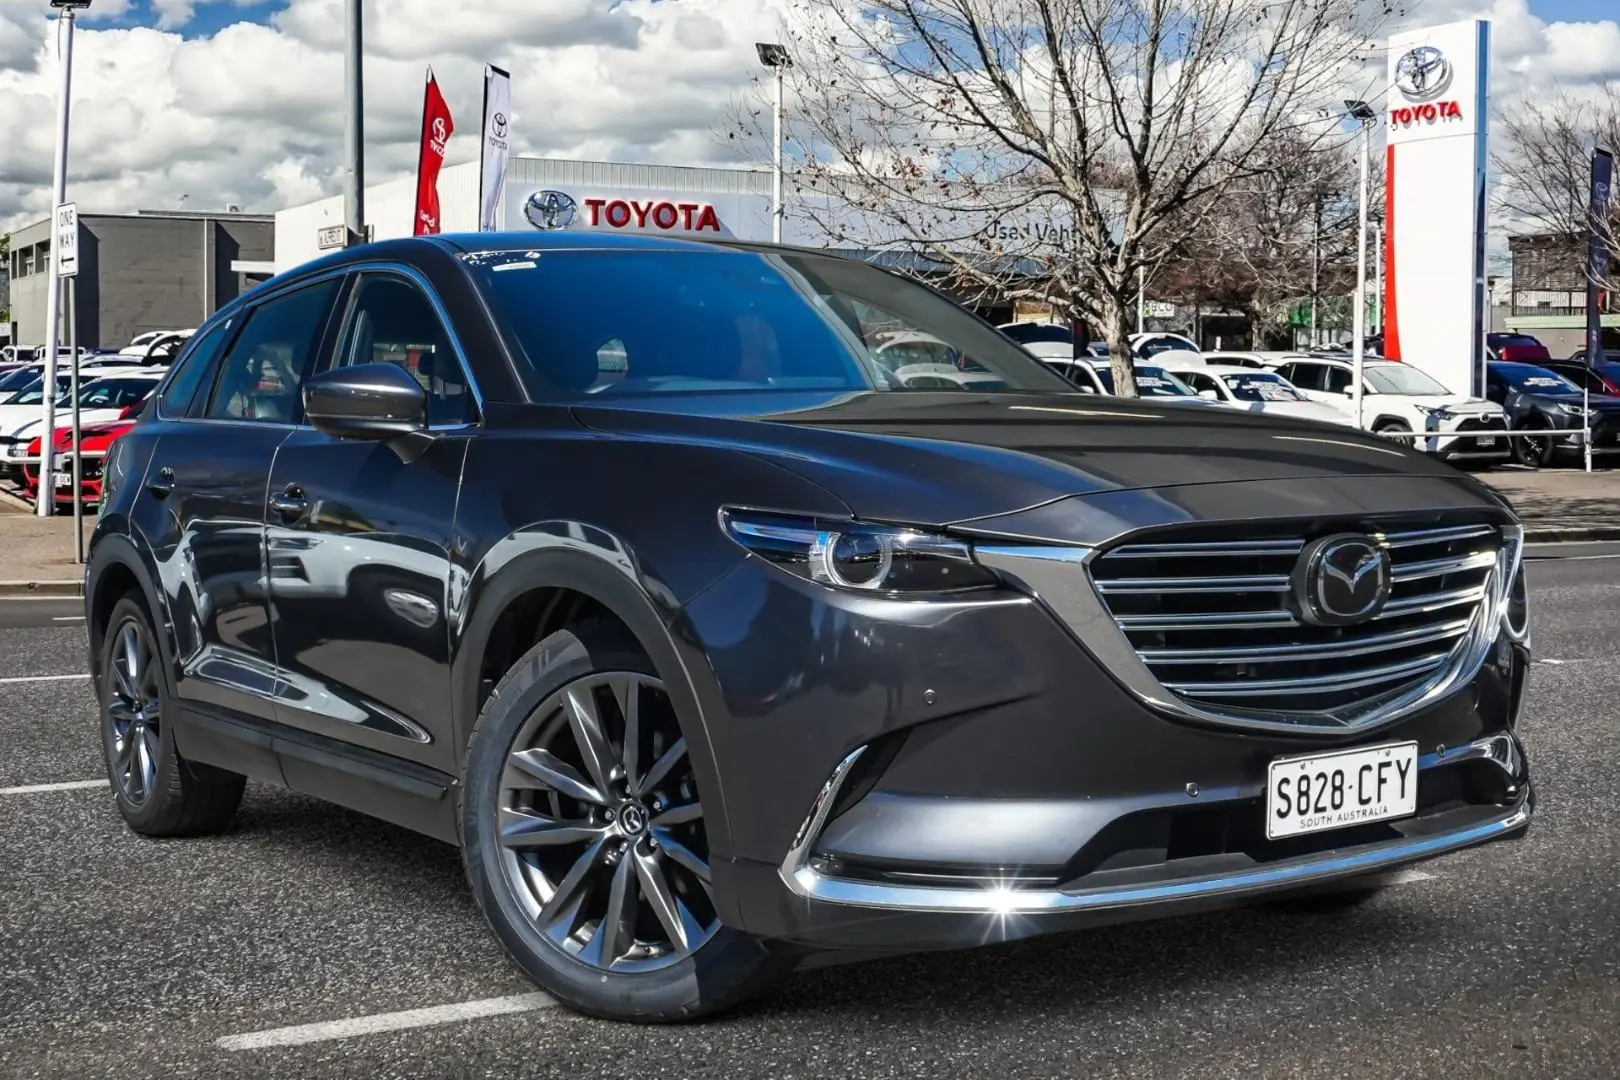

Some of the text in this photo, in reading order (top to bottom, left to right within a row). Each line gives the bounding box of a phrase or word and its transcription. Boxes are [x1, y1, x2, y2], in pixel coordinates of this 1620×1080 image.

[1390, 101, 1462, 124] TOYOTA
[60, 210, 74, 227] ONE
[584, 199, 720, 232] TOYOTA
[59, 232, 75, 248] WAY
[1300, 806, 1389, 829] SOUTH AUSTRALIA
